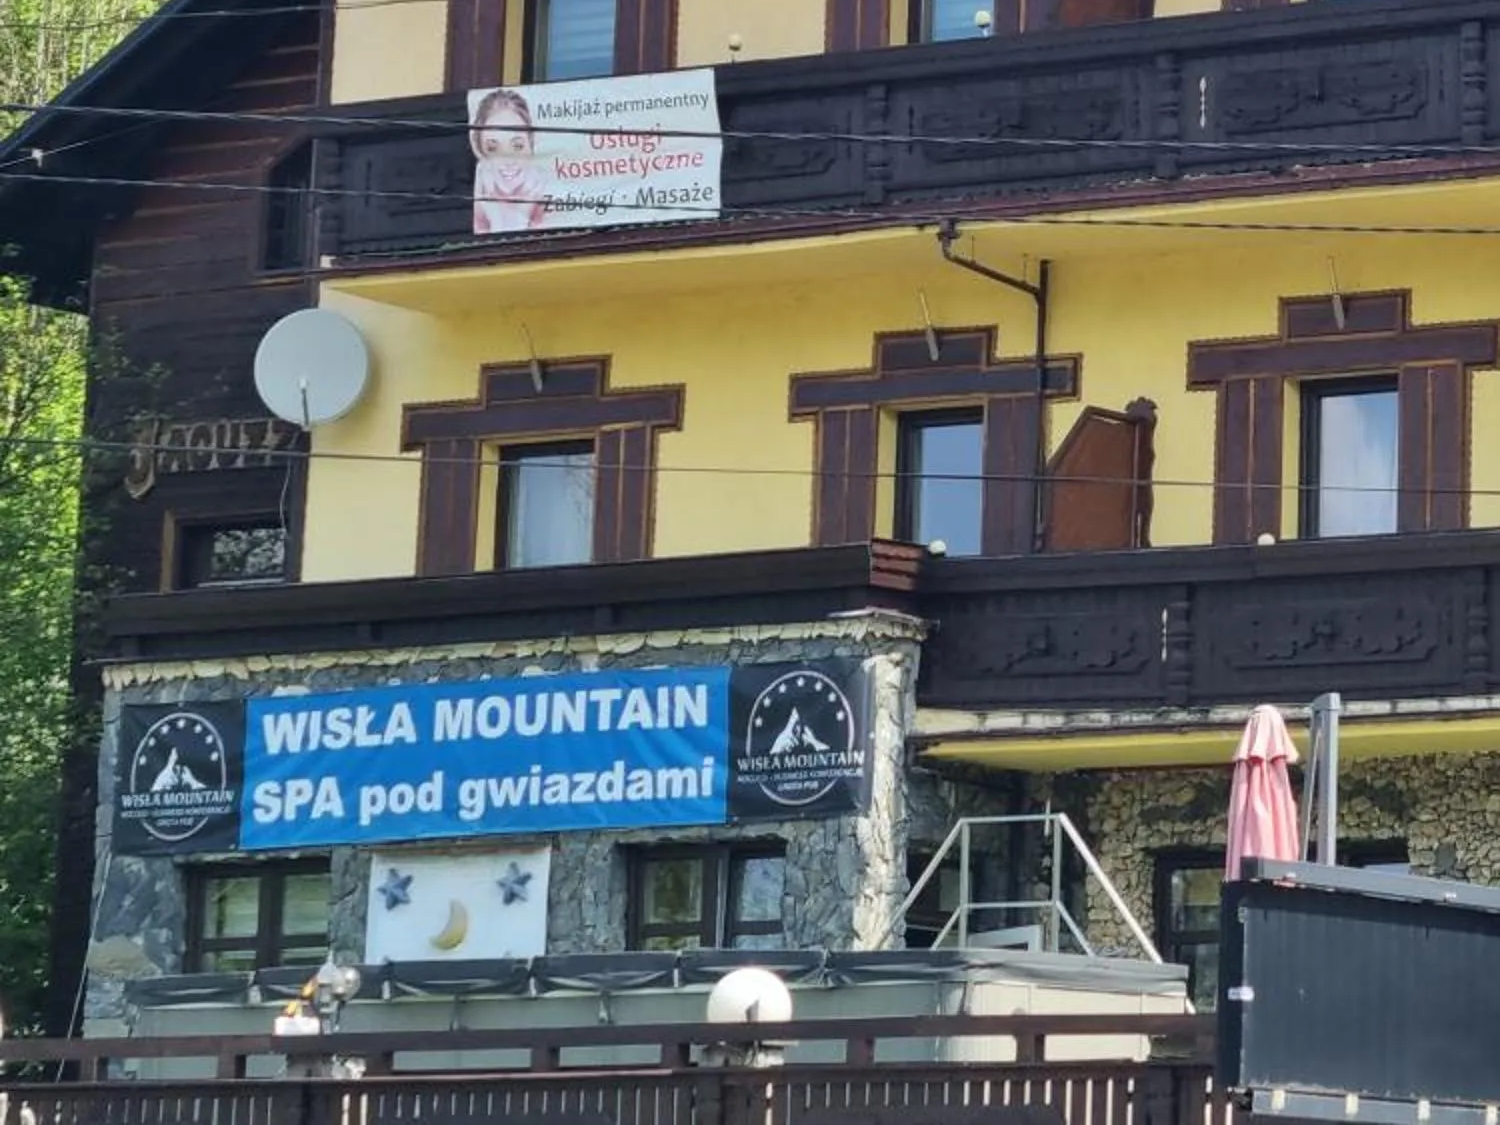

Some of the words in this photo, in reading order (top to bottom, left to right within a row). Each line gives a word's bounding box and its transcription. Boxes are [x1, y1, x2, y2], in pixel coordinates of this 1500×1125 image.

[537, 98, 601, 121] Makijaż
[605, 91, 709, 118] permanentny
[589, 123, 663, 154] Usługi
[555, 152, 704, 180] kosmetyczne
[543, 190, 614, 216] Zabiegi
[636, 182, 714, 207] Masaże
[261, 702, 417, 755] WISŁA
[434, 684, 708, 742] MOUNTAIN
[784, 750, 865, 769] MOUNTAIN
[163, 789, 235, 806] MOUNTAIN
[253, 776, 345, 824] SPA
[359, 771, 444, 826] pod
[458, 757, 715, 820] gwiazdami
